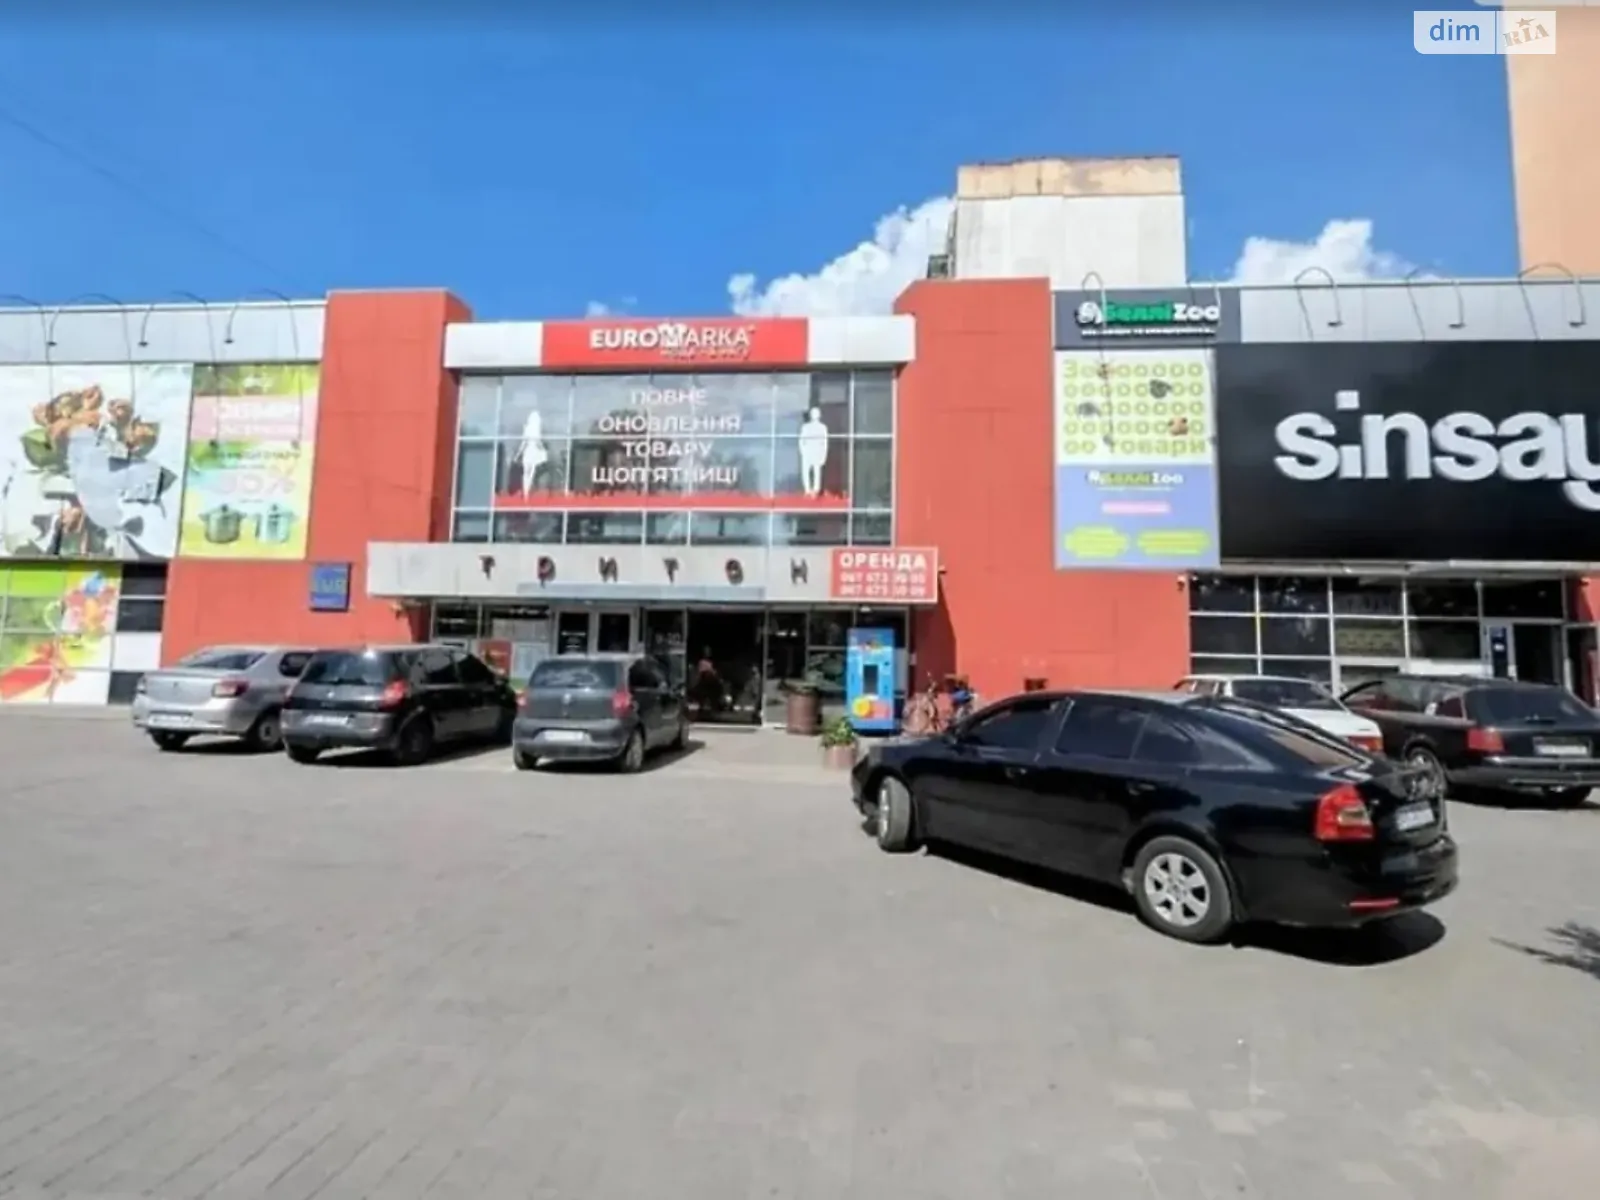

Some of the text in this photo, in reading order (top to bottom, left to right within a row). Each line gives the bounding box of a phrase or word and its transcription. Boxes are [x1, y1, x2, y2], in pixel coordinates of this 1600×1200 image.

[632, 388, 709, 405] ПОВНЕ
[598, 415, 741, 432] ОНОВЛЕННЯ
[621, 440, 714, 458] ТОВАРУ
[1274, 390, 1600, 511] sinsay
[839, 552, 927, 571] ОРЕНДА
